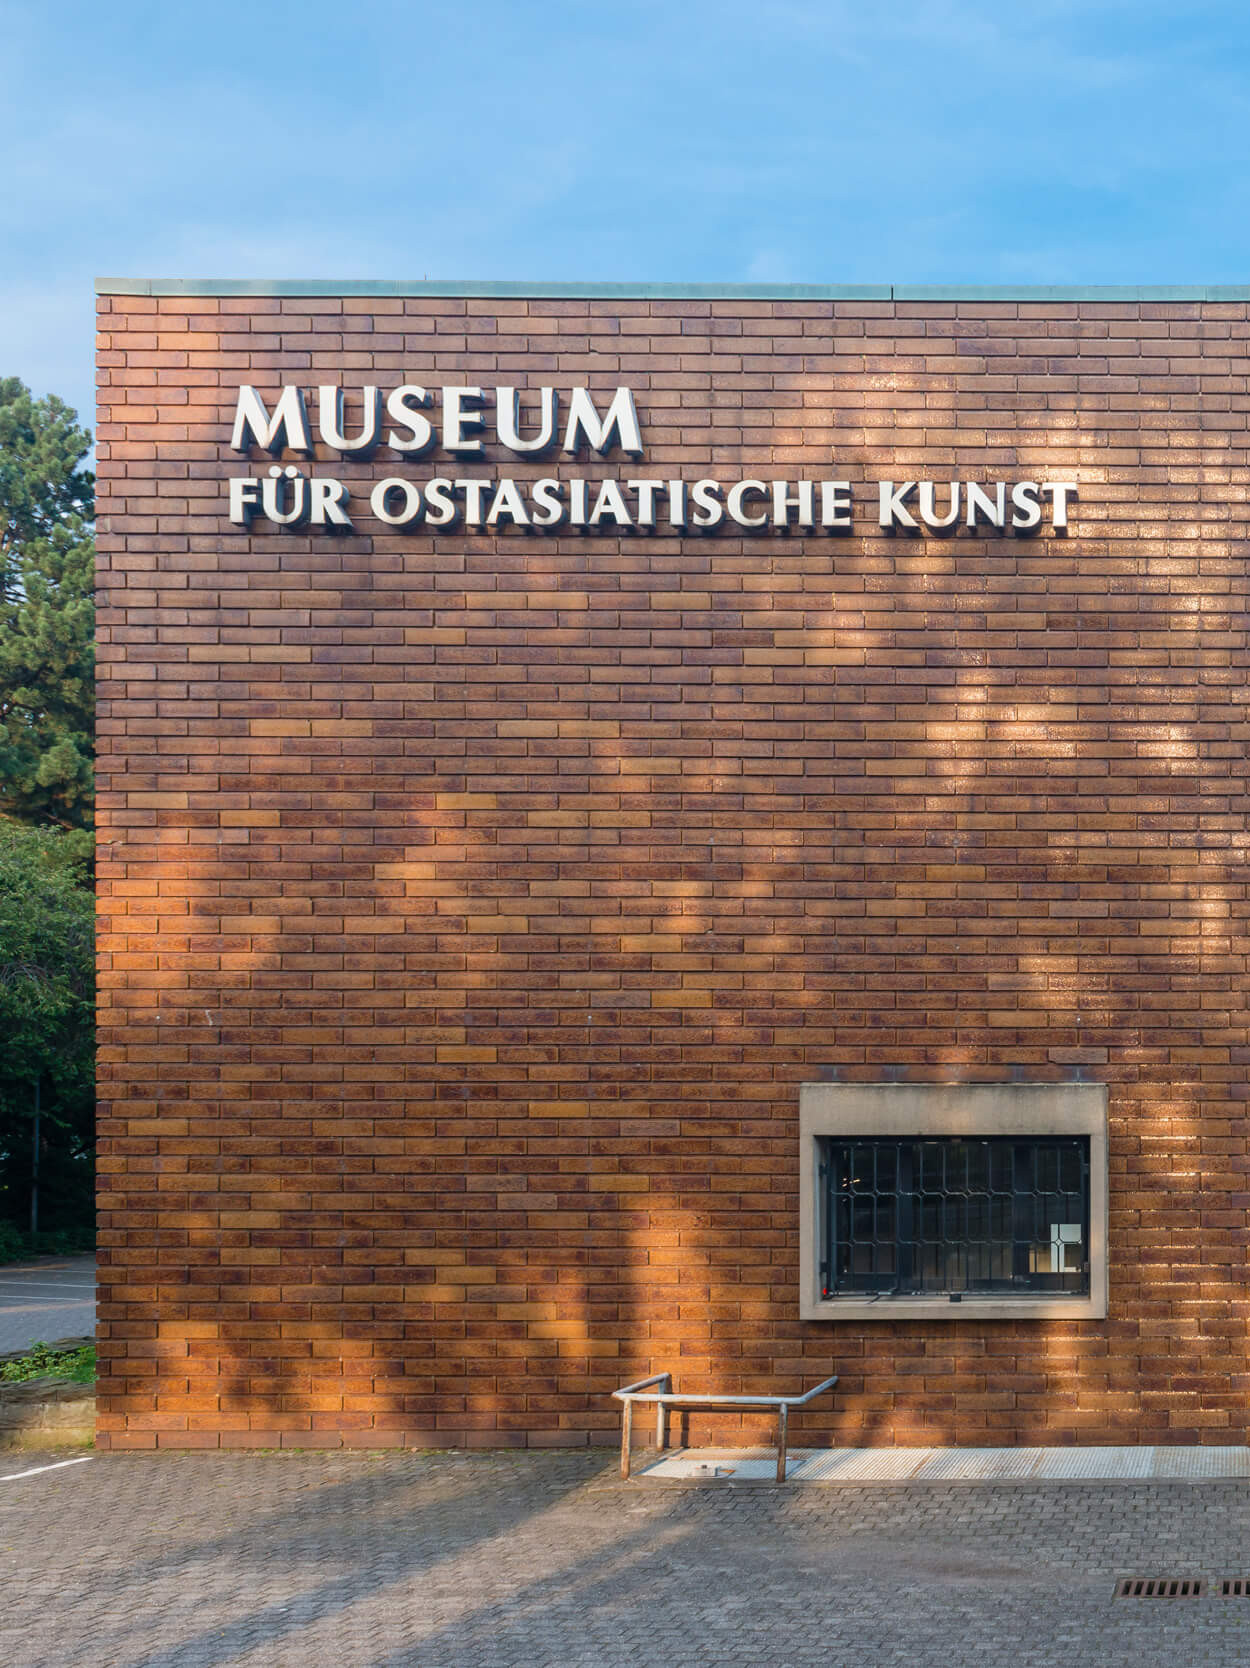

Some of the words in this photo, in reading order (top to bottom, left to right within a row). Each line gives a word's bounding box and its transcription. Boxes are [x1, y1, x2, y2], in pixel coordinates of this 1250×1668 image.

[230, 385, 644, 457] MUSEUM
[229, 465, 352, 527] FÜR
[369, 477, 852, 527] OSTASIATISCHE
[878, 479, 1079, 530] KUNST
